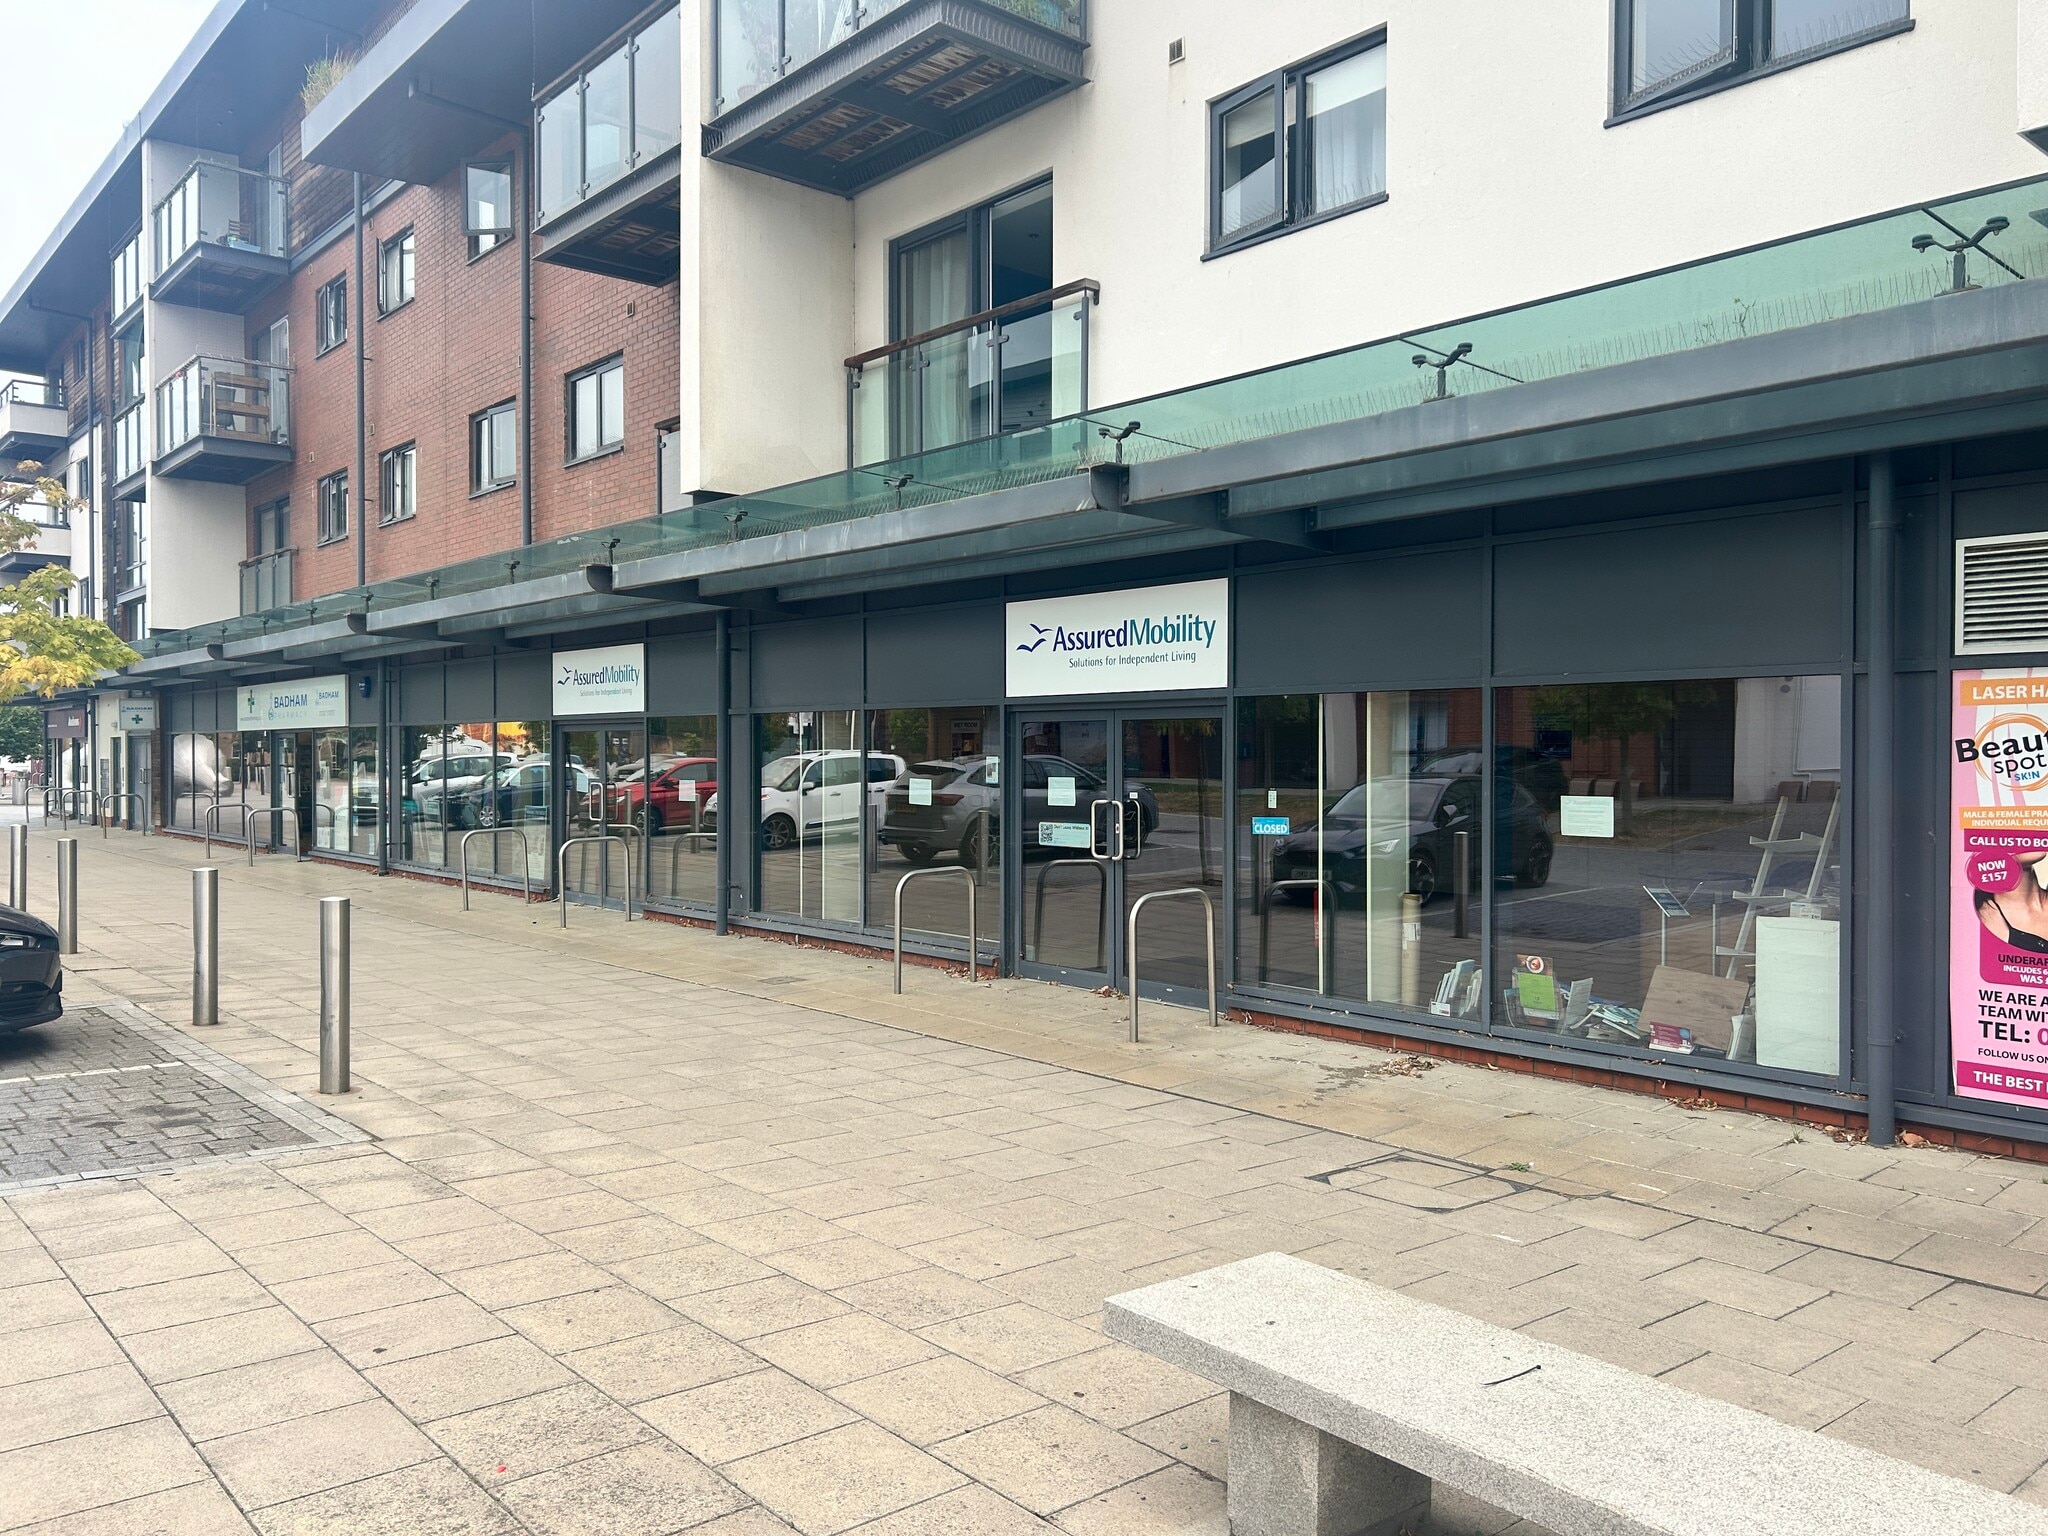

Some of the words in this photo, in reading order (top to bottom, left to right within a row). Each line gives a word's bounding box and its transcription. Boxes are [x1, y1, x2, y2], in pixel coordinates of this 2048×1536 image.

[1053, 613, 1217, 651] AssuredMobility
[1068, 657, 1103, 668] Solutions
[1105, 655, 1117, 666] for
[1119, 652, 1169, 666] Independent
[1171, 650, 1197, 664] Living
[572, 664, 641, 687] AssuredMobility
[318, 690, 340, 700] BADHAM
[1972, 684, 2027, 701] LASER
[274, 693, 308, 709] BADHAM
[1993, 753, 2048, 779] spot
[1996, 810, 2029, 818] FEMALE
[1254, 824, 1288, 834] CLOSED
[1971, 819, 2021, 827] INDIVIDUAL
[1969, 836, 1997, 846] CALL
[1999, 837, 2014, 847] US
[2015, 838, 2031, 847] TO
[1977, 859, 2006, 872] NOW
[1981, 871, 2008, 883] £157
[2003, 964, 2042, 975] INCLUDES
[2019, 974, 2043, 985] WAS
[1978, 989, 2003, 1003] WE
[2005, 992, 2037, 1007] ARE
[1978, 1004, 2022, 1021] TEAM
[2025, 1009, 2048, 1023] WI
[1978, 1019, 2031, 1044] TEL:
[1978, 1047, 2019, 1060] FOLLOW
[2021, 1053, 2035, 1062] US
[1973, 1070, 2003, 1086] THE
[2005, 1075, 2044, 1092] BEST
